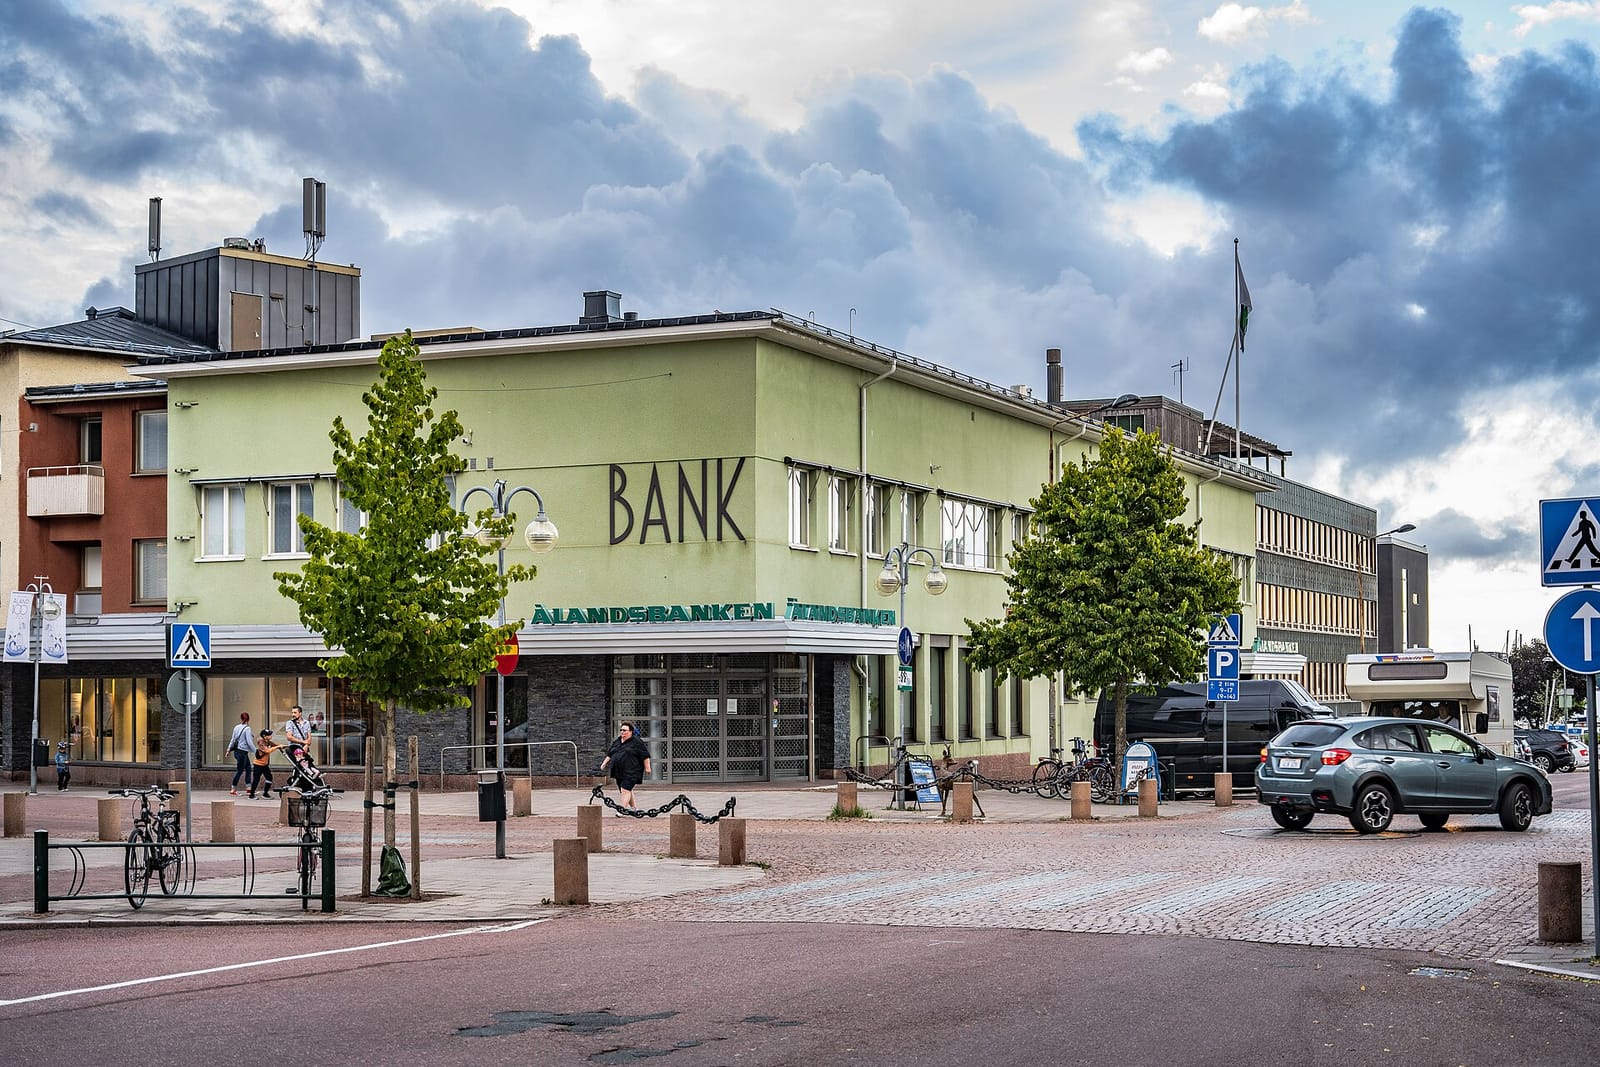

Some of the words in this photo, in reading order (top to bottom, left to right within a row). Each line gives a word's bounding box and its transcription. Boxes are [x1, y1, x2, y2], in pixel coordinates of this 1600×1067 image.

[609, 456, 746, 545] BANK
[531, 602, 775, 625] ÅLANDSBANKEN
[784, 597, 896, 627] ÅLANDSBANKEN
[1216, 651, 1233, 676] P
